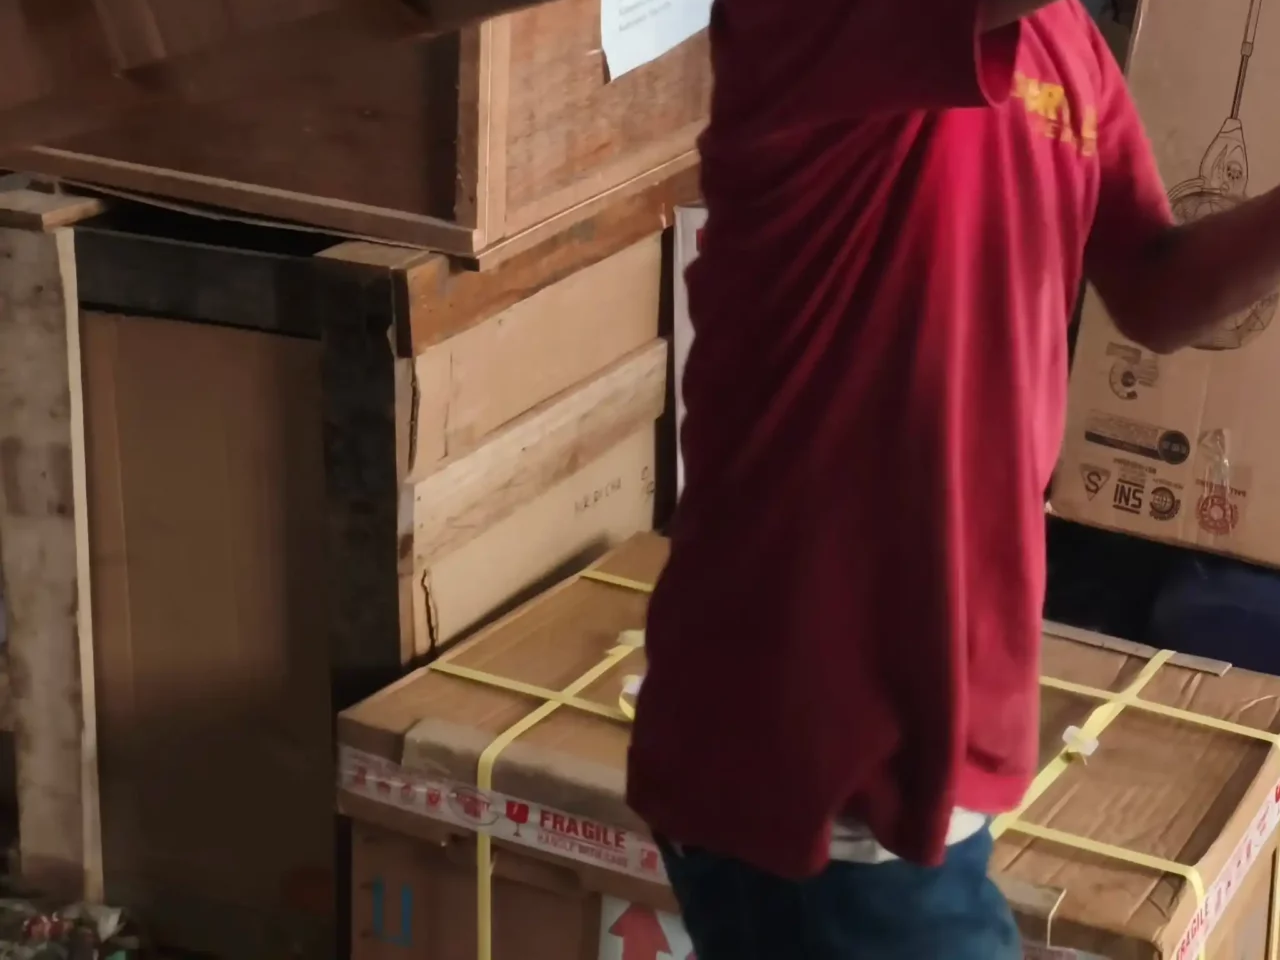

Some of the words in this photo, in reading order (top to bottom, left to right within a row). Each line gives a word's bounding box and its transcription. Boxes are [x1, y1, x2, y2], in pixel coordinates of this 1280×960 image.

[1087, 471, 1102, 493] S
[1113, 484, 1143, 509] SNI
[538, 808, 627, 849] FRAGILE
